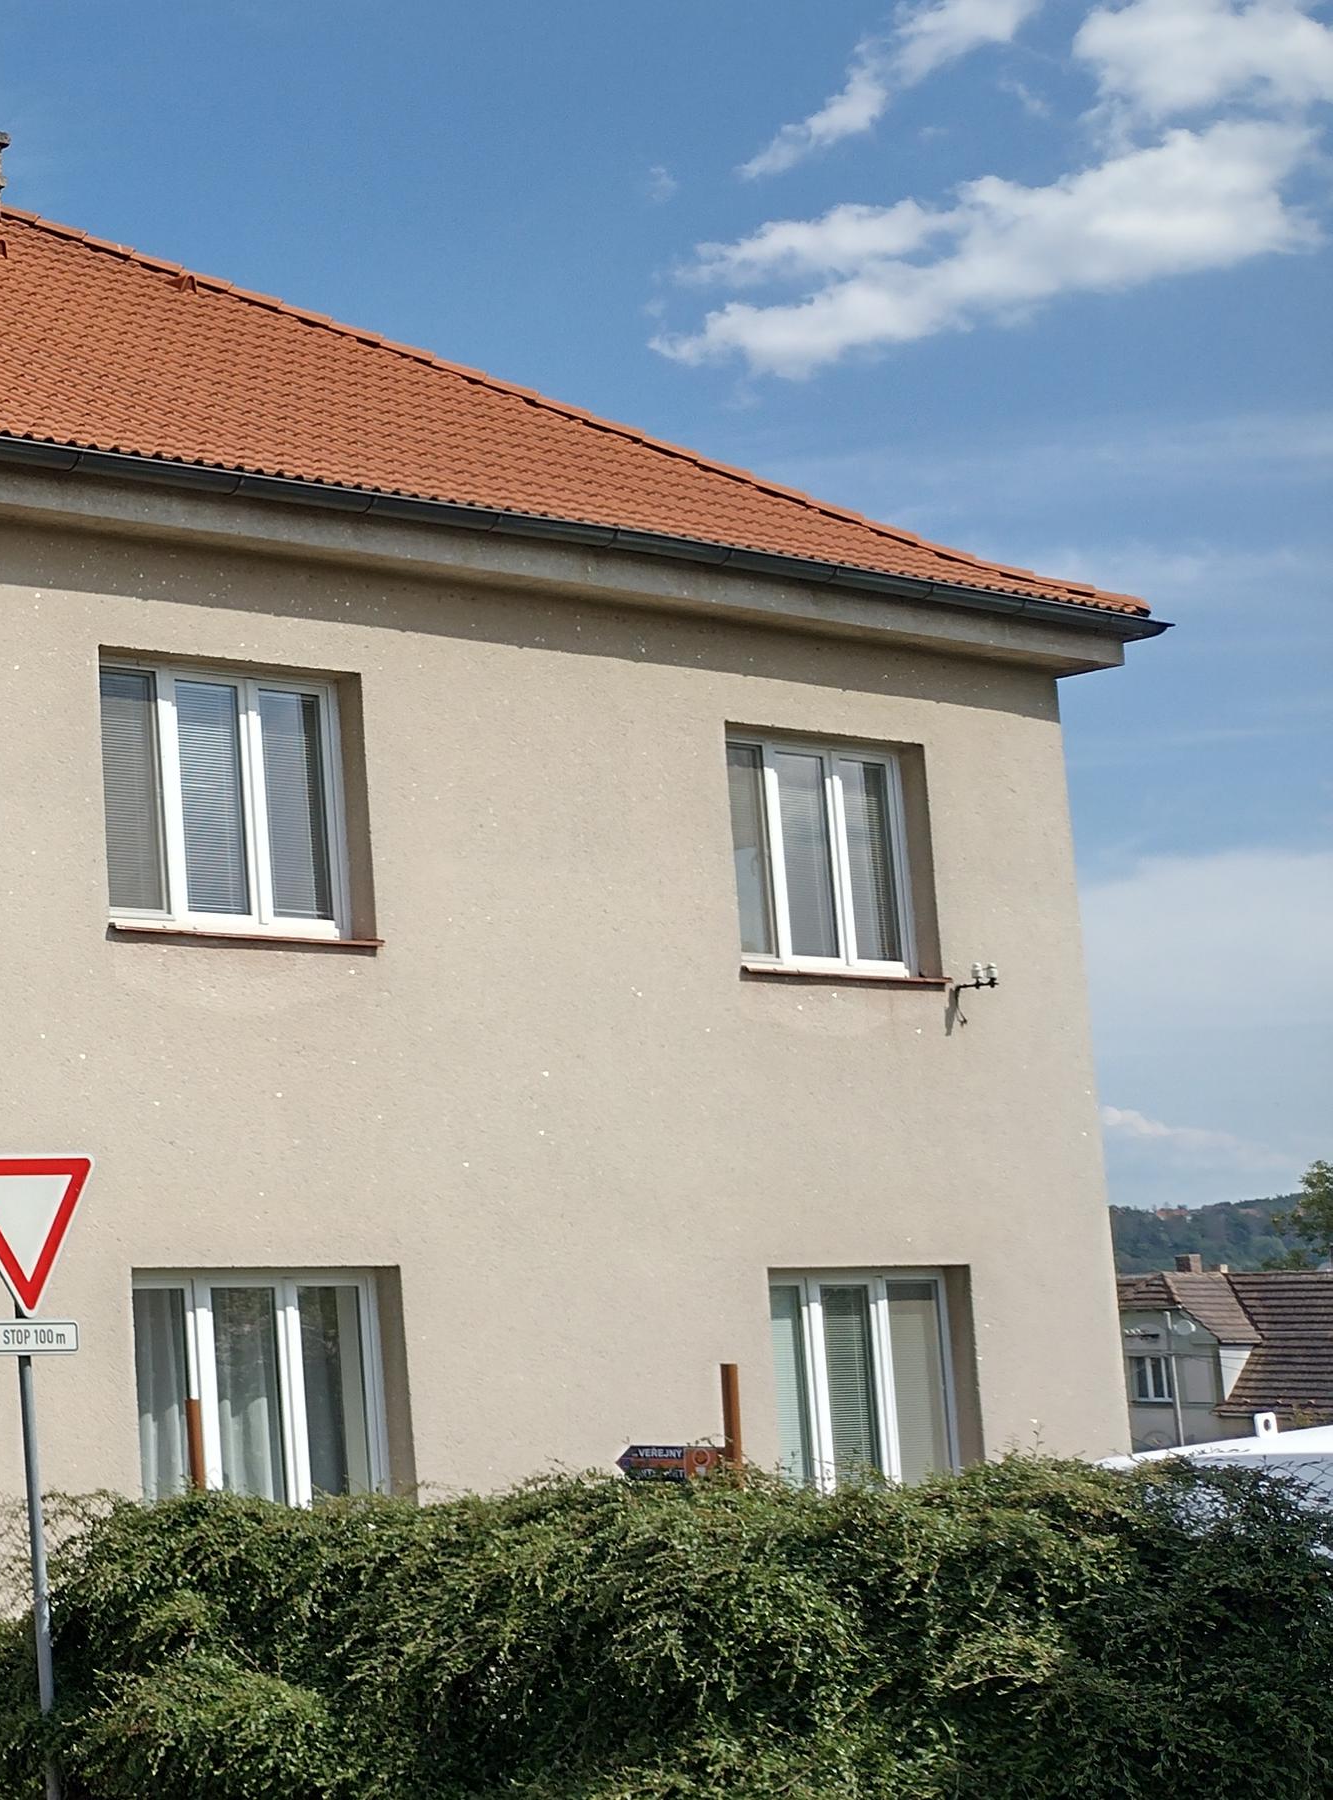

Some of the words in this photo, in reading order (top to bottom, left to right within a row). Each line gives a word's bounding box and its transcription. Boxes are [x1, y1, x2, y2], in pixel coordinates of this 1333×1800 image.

[3, 1329, 30, 1344] STOP
[34, 1328, 54, 1344] 100
[56, 1333, 66, 1344] m
